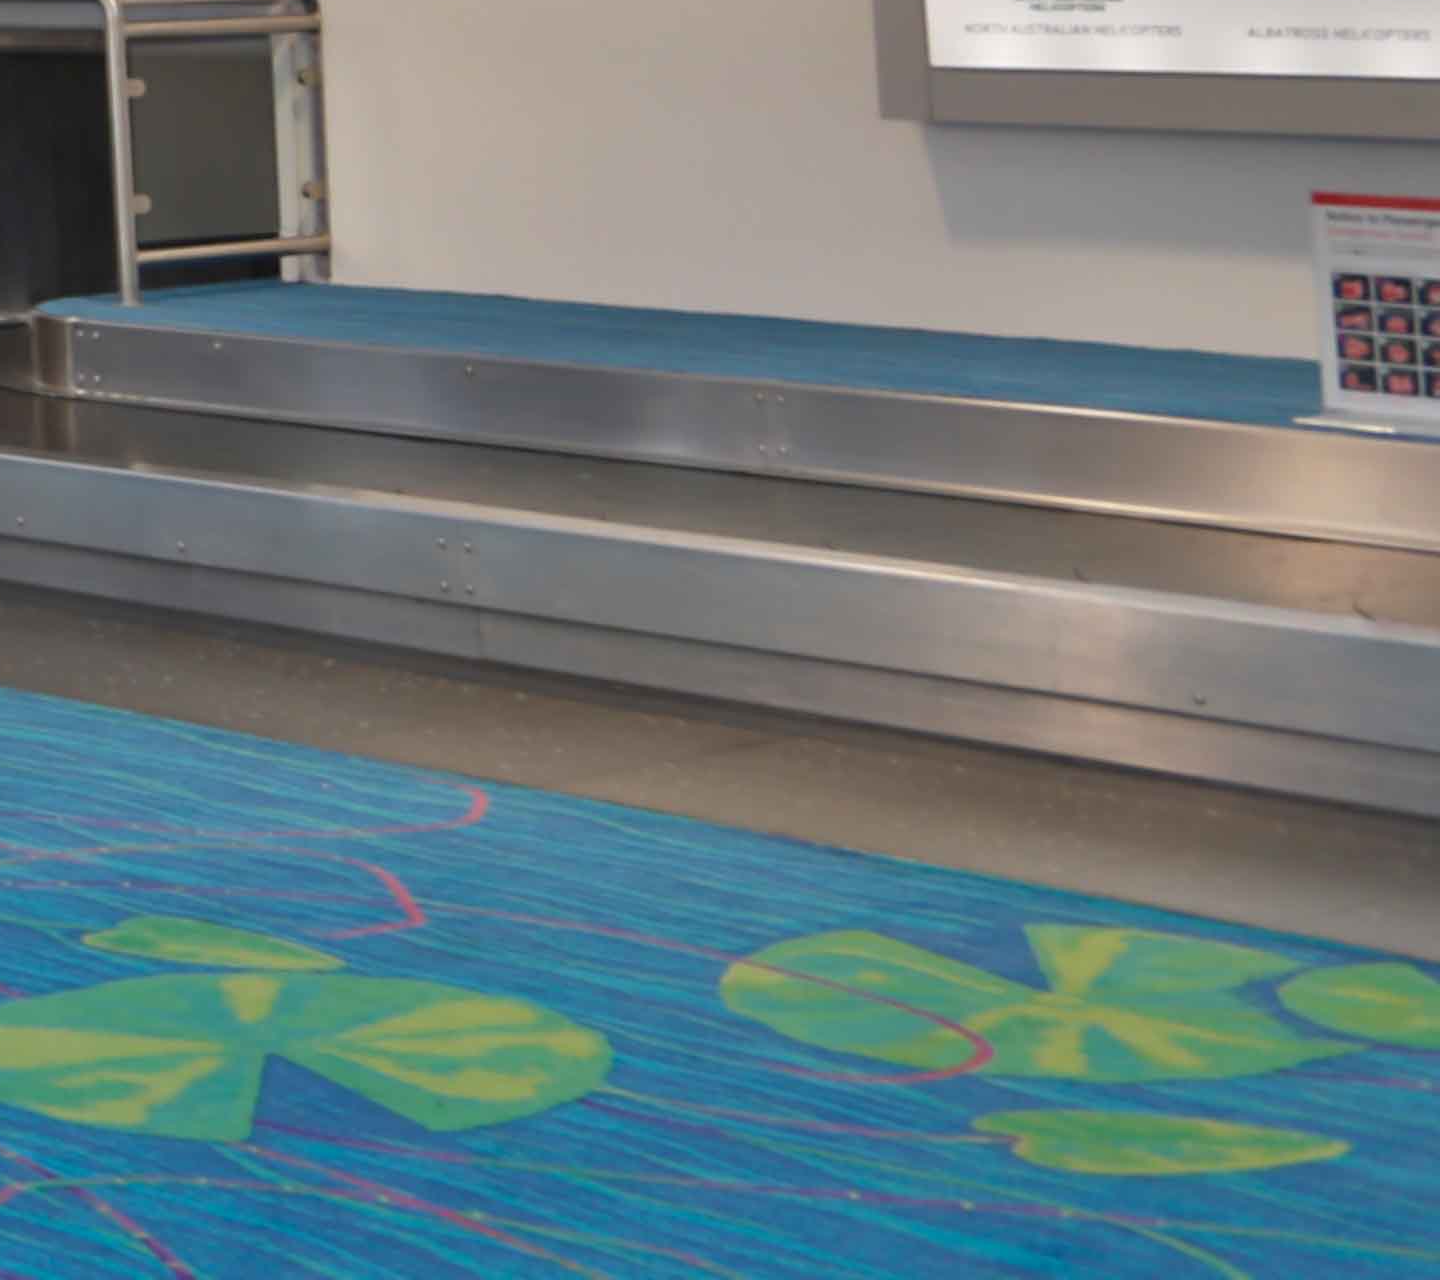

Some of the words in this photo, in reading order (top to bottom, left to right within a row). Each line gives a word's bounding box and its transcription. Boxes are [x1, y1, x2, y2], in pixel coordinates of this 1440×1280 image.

[1011, 23, 1091, 35] AUSTRALIAN
[1094, 23, 1183, 37] HELICOPTERS
[1247, 26, 1330, 39] ALBATROSS
[1333, 26, 1431, 40] HELICOPTERS
